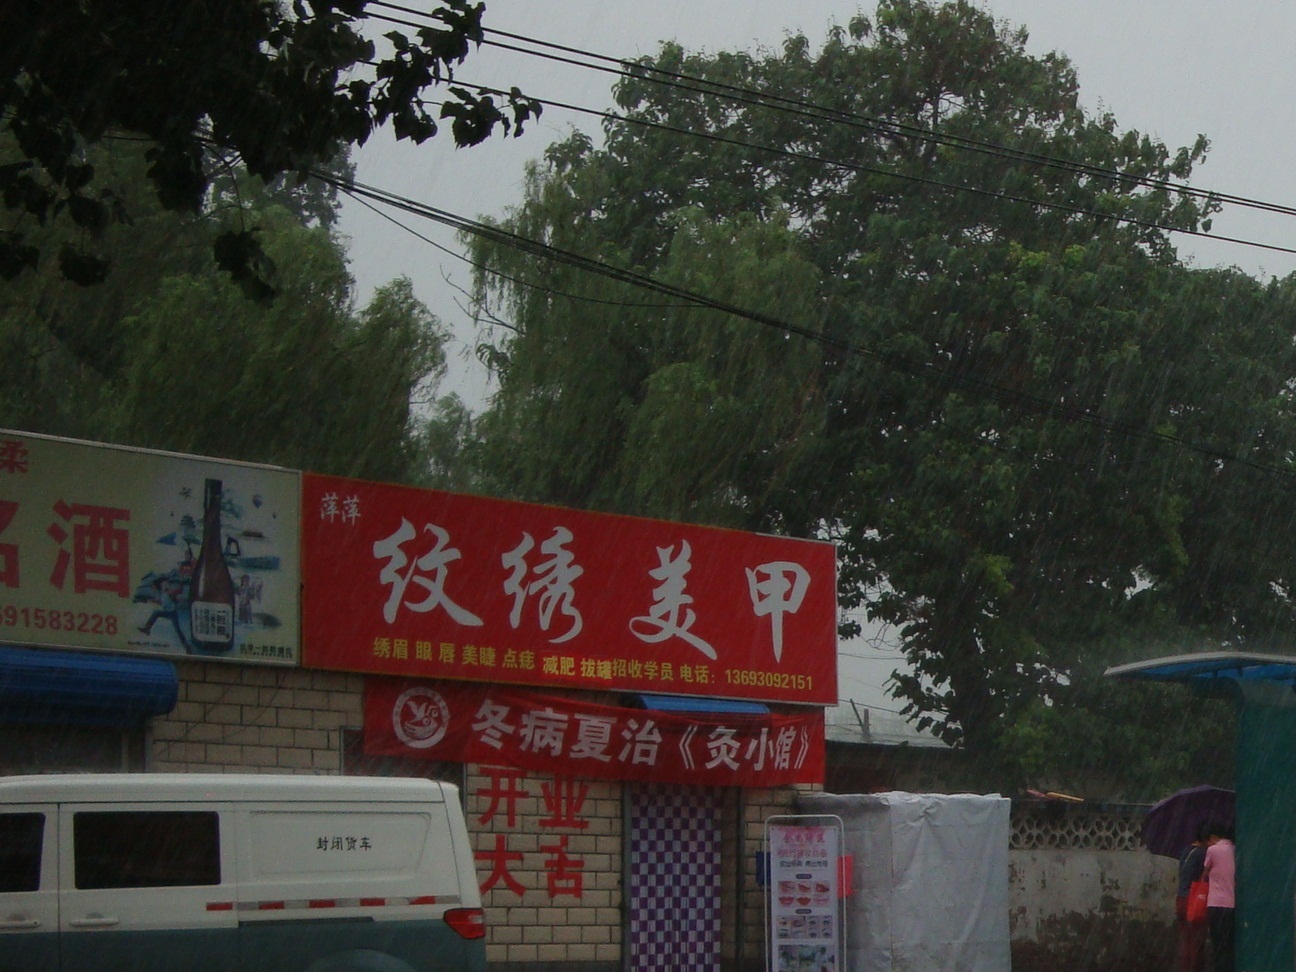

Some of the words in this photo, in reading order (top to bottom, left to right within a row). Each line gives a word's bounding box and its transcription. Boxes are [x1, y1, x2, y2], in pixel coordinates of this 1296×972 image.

[373, 515, 811, 663] 纹绣美甲
[373, 636, 409, 661] 绣眉
[415, 640, 433, 662] 眼
[438, 642, 456, 665] 唇
[542, 655, 575, 676] 减肥
[471, 698, 809, 773] 冬病夏治《灸小馆》
[476, 766, 590, 830] 开业
[316, 836, 372, 851] 封闭货车
